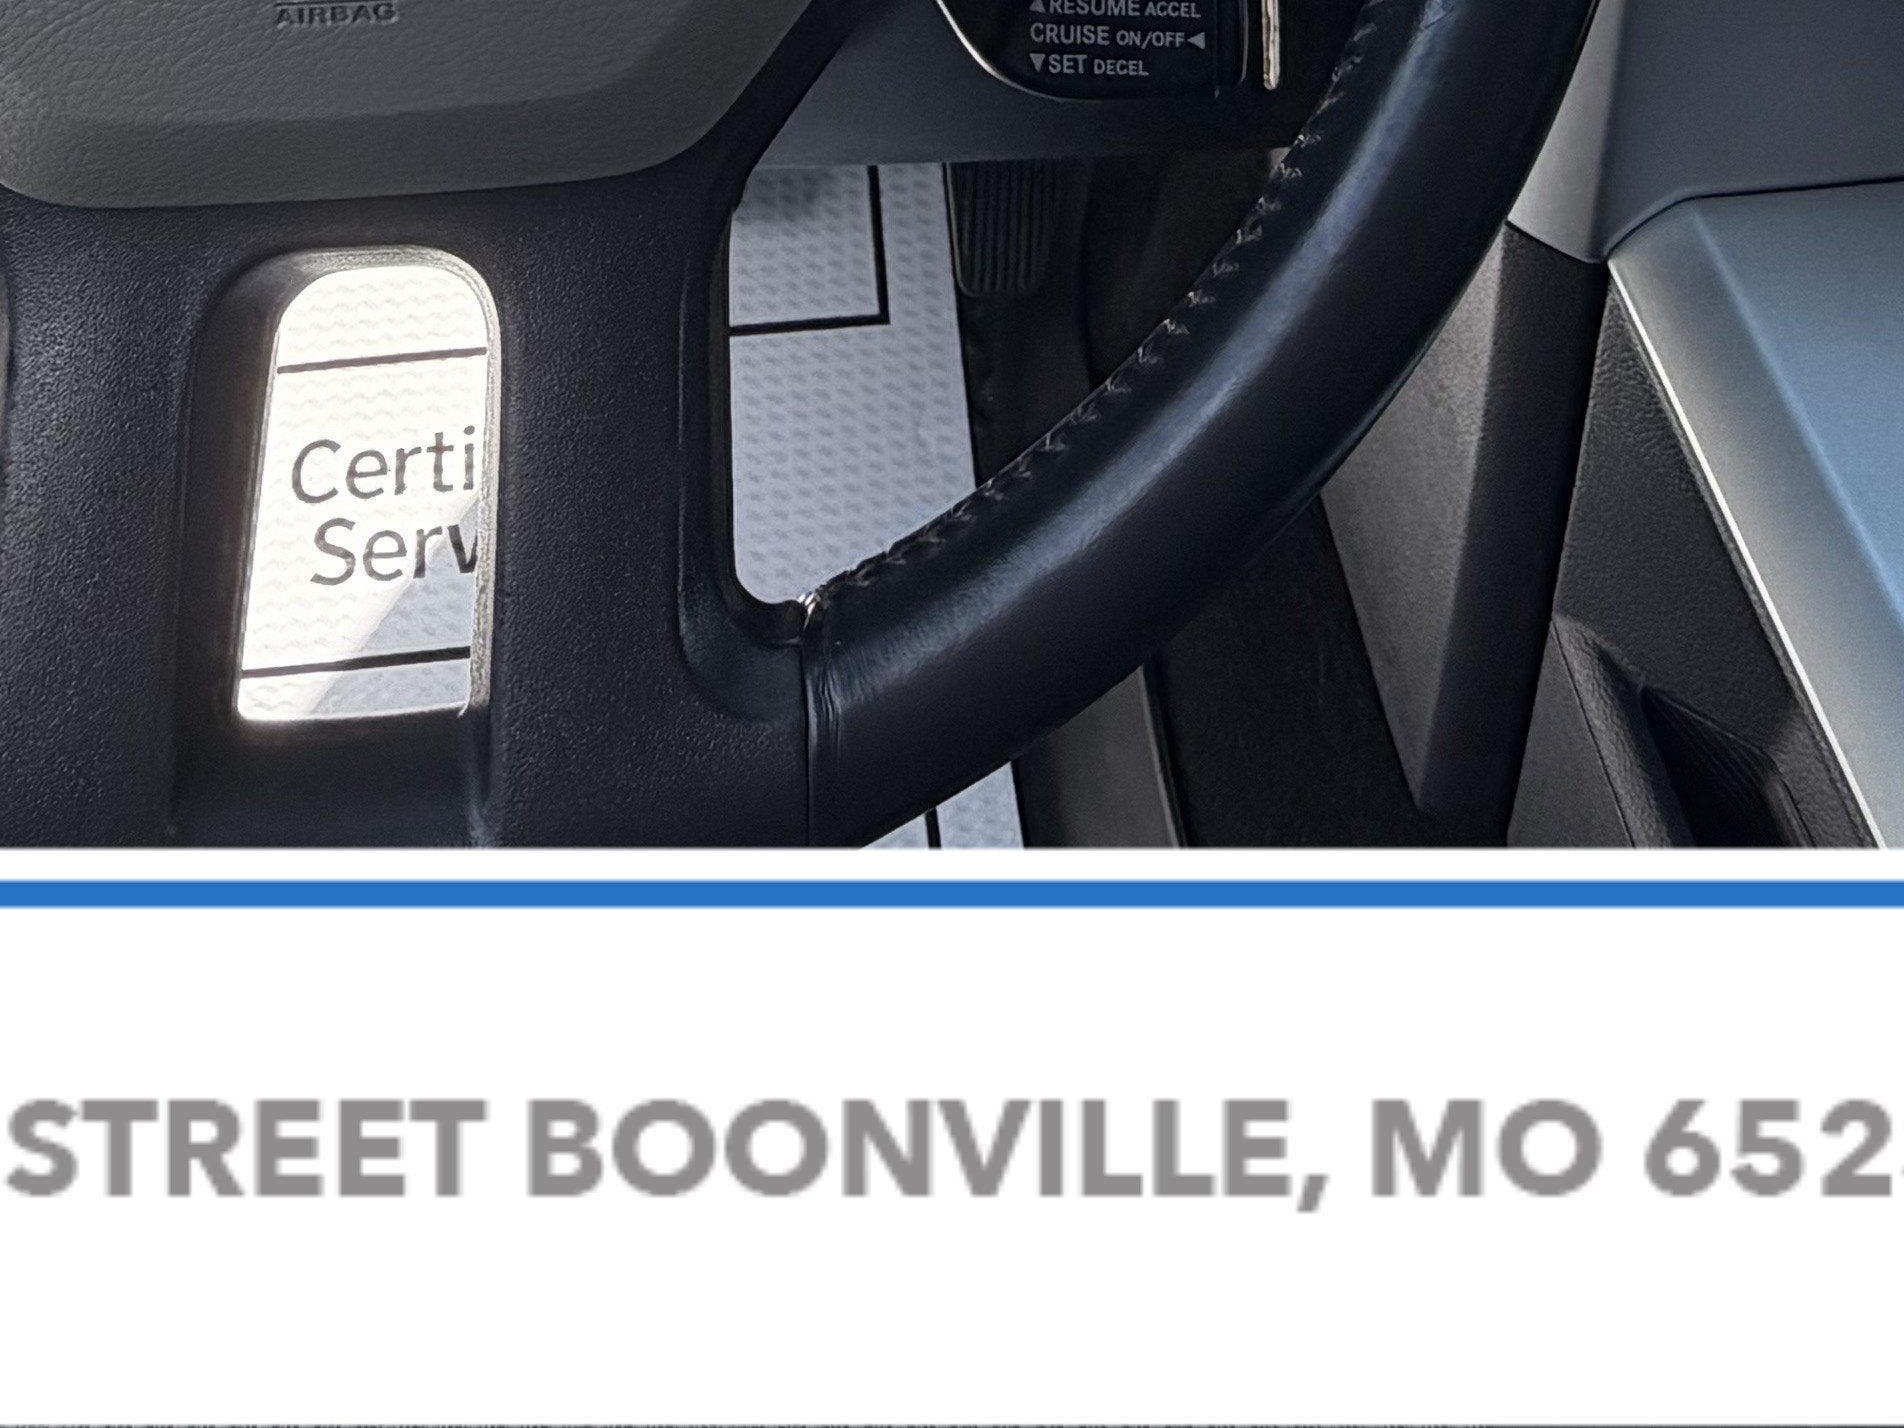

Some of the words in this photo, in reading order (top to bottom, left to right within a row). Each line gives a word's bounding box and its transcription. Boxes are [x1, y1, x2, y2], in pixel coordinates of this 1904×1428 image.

[274, 3, 399, 26] AIRBAG
[1144, 1, 1201, 19] ACCEL
[1029, 22, 1110, 45] CRUISE
[1115, 30, 1186, 50] ON/OFF
[1048, 54, 1088, 75] SET
[1093, 59, 1149, 77] DECEL
